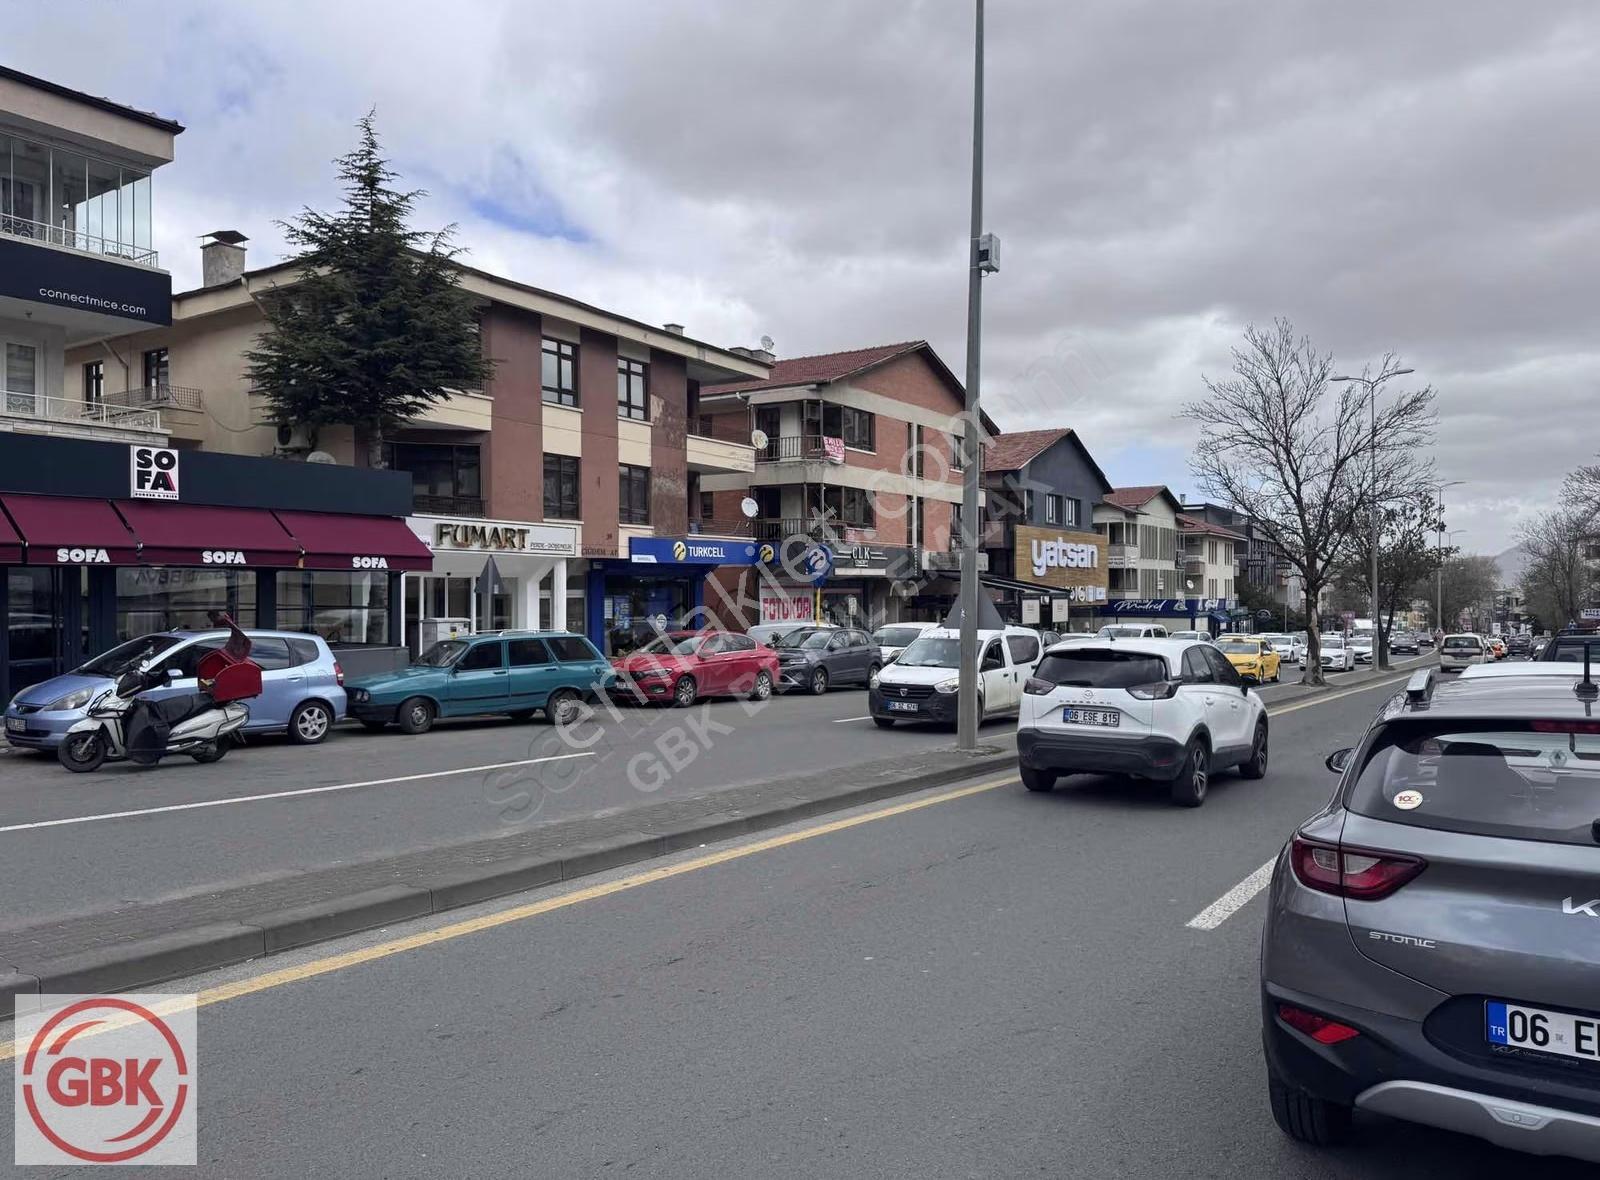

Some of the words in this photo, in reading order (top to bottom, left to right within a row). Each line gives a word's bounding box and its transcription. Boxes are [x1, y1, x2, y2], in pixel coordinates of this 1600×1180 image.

[39, 287, 147, 316] connectmice.com
[435, 523, 531, 550] FUMART
[56, 548, 110, 563] SOFA
[202, 550, 246, 565] SOFA
[688, 546, 725, 558] TURKCELL
[852, 546, 870, 560] CLK
[1031, 536, 1098, 577] yatsan
[352, 556, 389, 569] SOFA
[1070, 710, 1079, 720] 06
[1083, 711, 1098, 722] ESE
[1102, 713, 1118, 723] 815
[1369, 931, 1436, 949] STONIC
[1490, 1025, 1505, 1036] TR
[1508, 1010, 1550, 1047] 06
[1574, 1019, 1600, 1056] E
